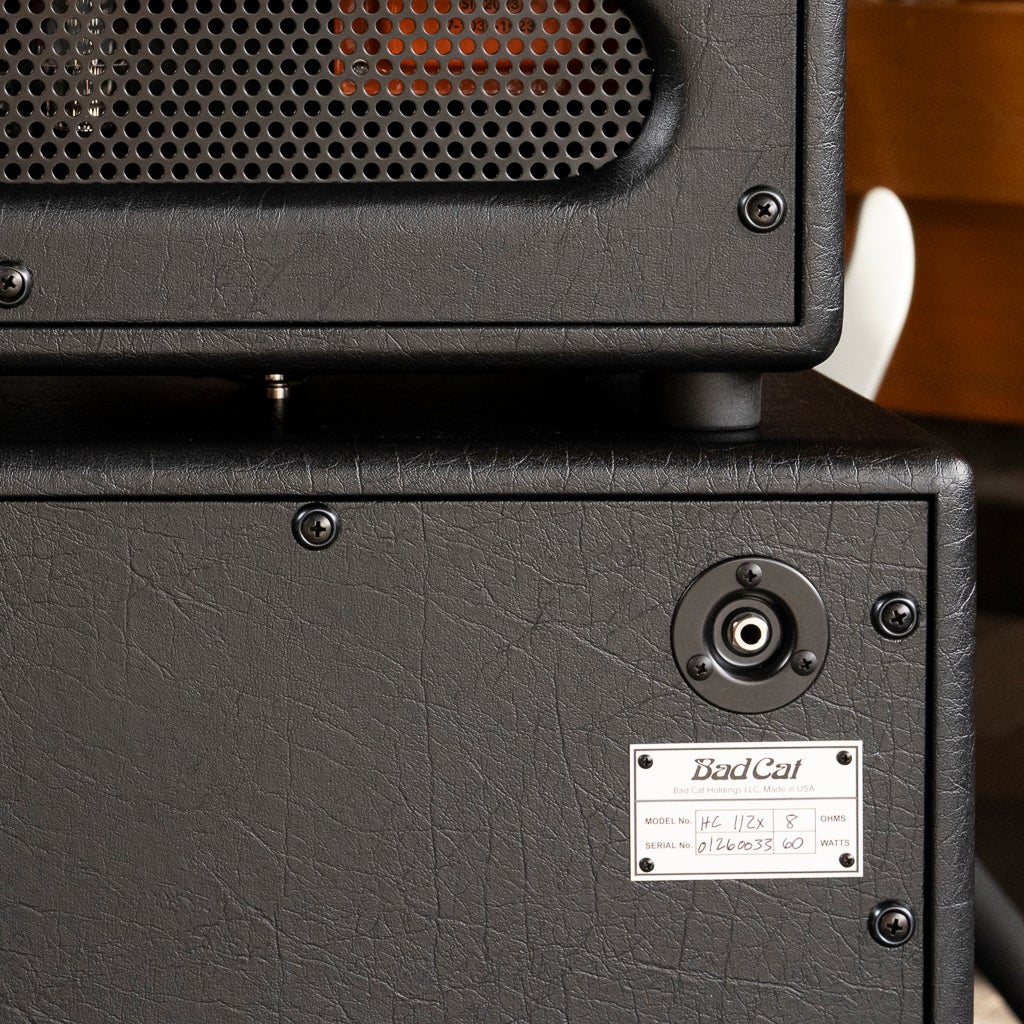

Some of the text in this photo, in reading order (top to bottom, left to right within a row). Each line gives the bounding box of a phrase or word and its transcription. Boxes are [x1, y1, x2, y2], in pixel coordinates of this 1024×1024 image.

[690, 757, 803, 781] Bad Cat
[673, 786, 690, 795] Bad
[691, 786, 705, 794] Cat
[706, 786, 743, 795] Holdings
[744, 786, 762, 794] LLC,
[763, 785, 786, 793] Made
[797, 784, 815, 793] USA
[645, 817, 692, 825] MODEL No.
[785, 813, 799, 830] 8
[820, 814, 846, 823] OHMS
[645, 841, 693, 850] SERIAL No.
[697, 837, 773, 854] 01260033
[782, 836, 804, 850] 60
[820, 839, 850, 847] WATTS
